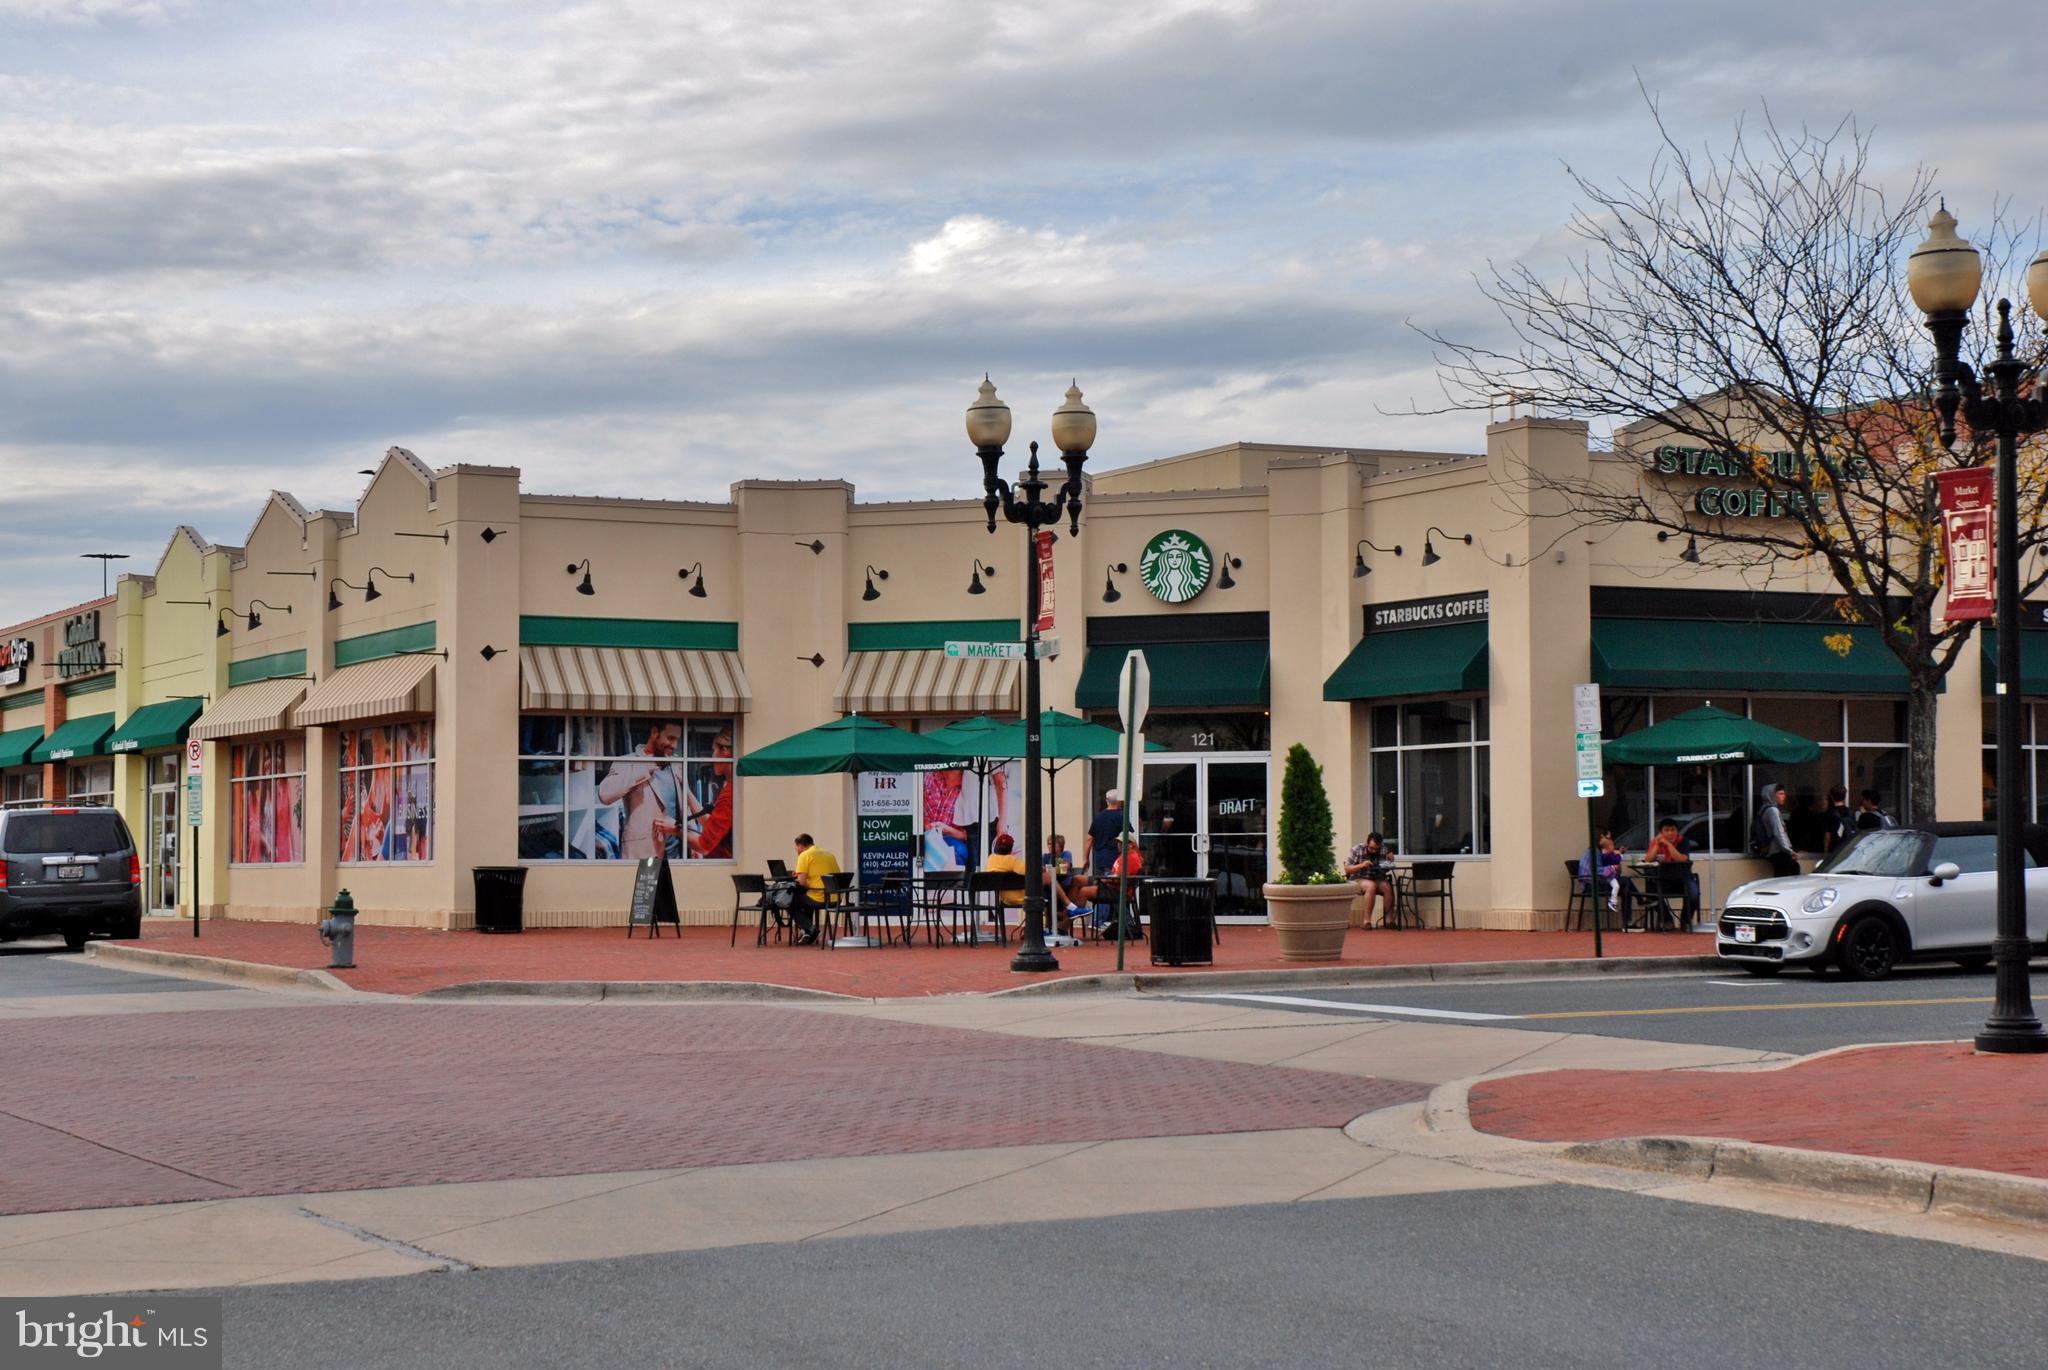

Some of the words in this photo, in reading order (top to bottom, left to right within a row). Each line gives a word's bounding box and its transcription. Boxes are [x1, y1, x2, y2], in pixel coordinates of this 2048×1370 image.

[1954, 486, 1979, 496] Market
[1955, 500, 1980, 510] Square
[1375, 604, 1443, 625] STARBUCKS
[1445, 598, 1489, 617] COFFEE
[967, 645, 1011, 657] MARKET
[1191, 733, 1214, 746] 121
[1677, 754, 1717, 762] STARBUCKS
[1219, 798, 1256, 815] DRAFT
[863, 820, 891, 829] NOW
[863, 832, 909, 841] LEASING!
[863, 852, 885, 860] KEVIN
[886, 852, 909, 860] ALLEN
[863, 861, 879, 869] (410)
